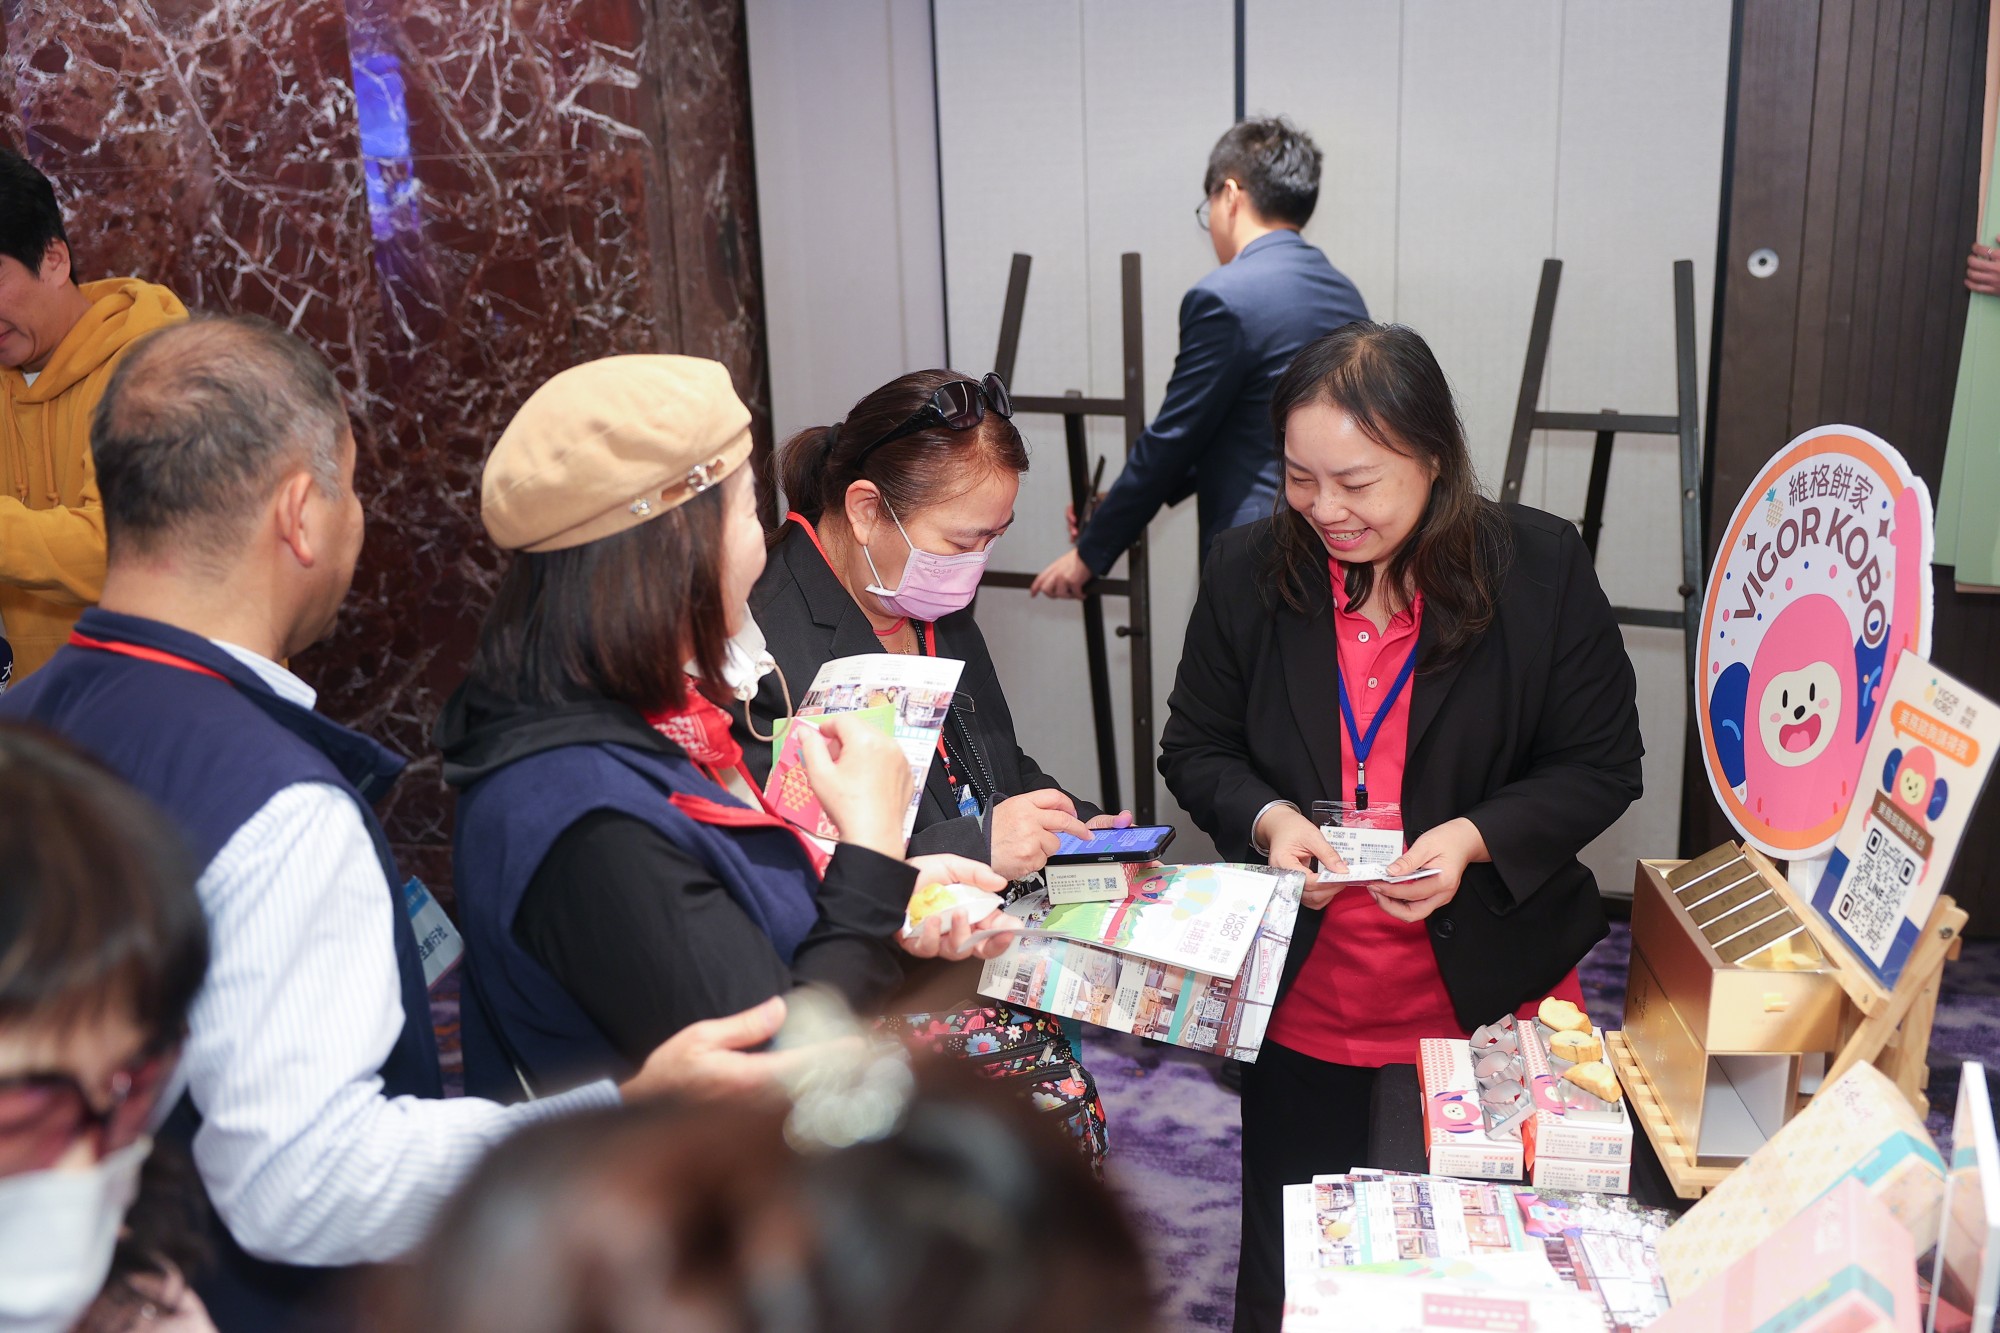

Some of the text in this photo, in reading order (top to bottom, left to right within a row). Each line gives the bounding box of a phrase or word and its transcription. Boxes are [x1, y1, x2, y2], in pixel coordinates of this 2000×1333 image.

[1789, 463, 1874, 515] 維格餅家
[1733, 506, 1886, 645] VIGOR KOBO
[1220, 912, 1237, 937] KOBO
[1231, 915, 1248, 941] VIGOR
